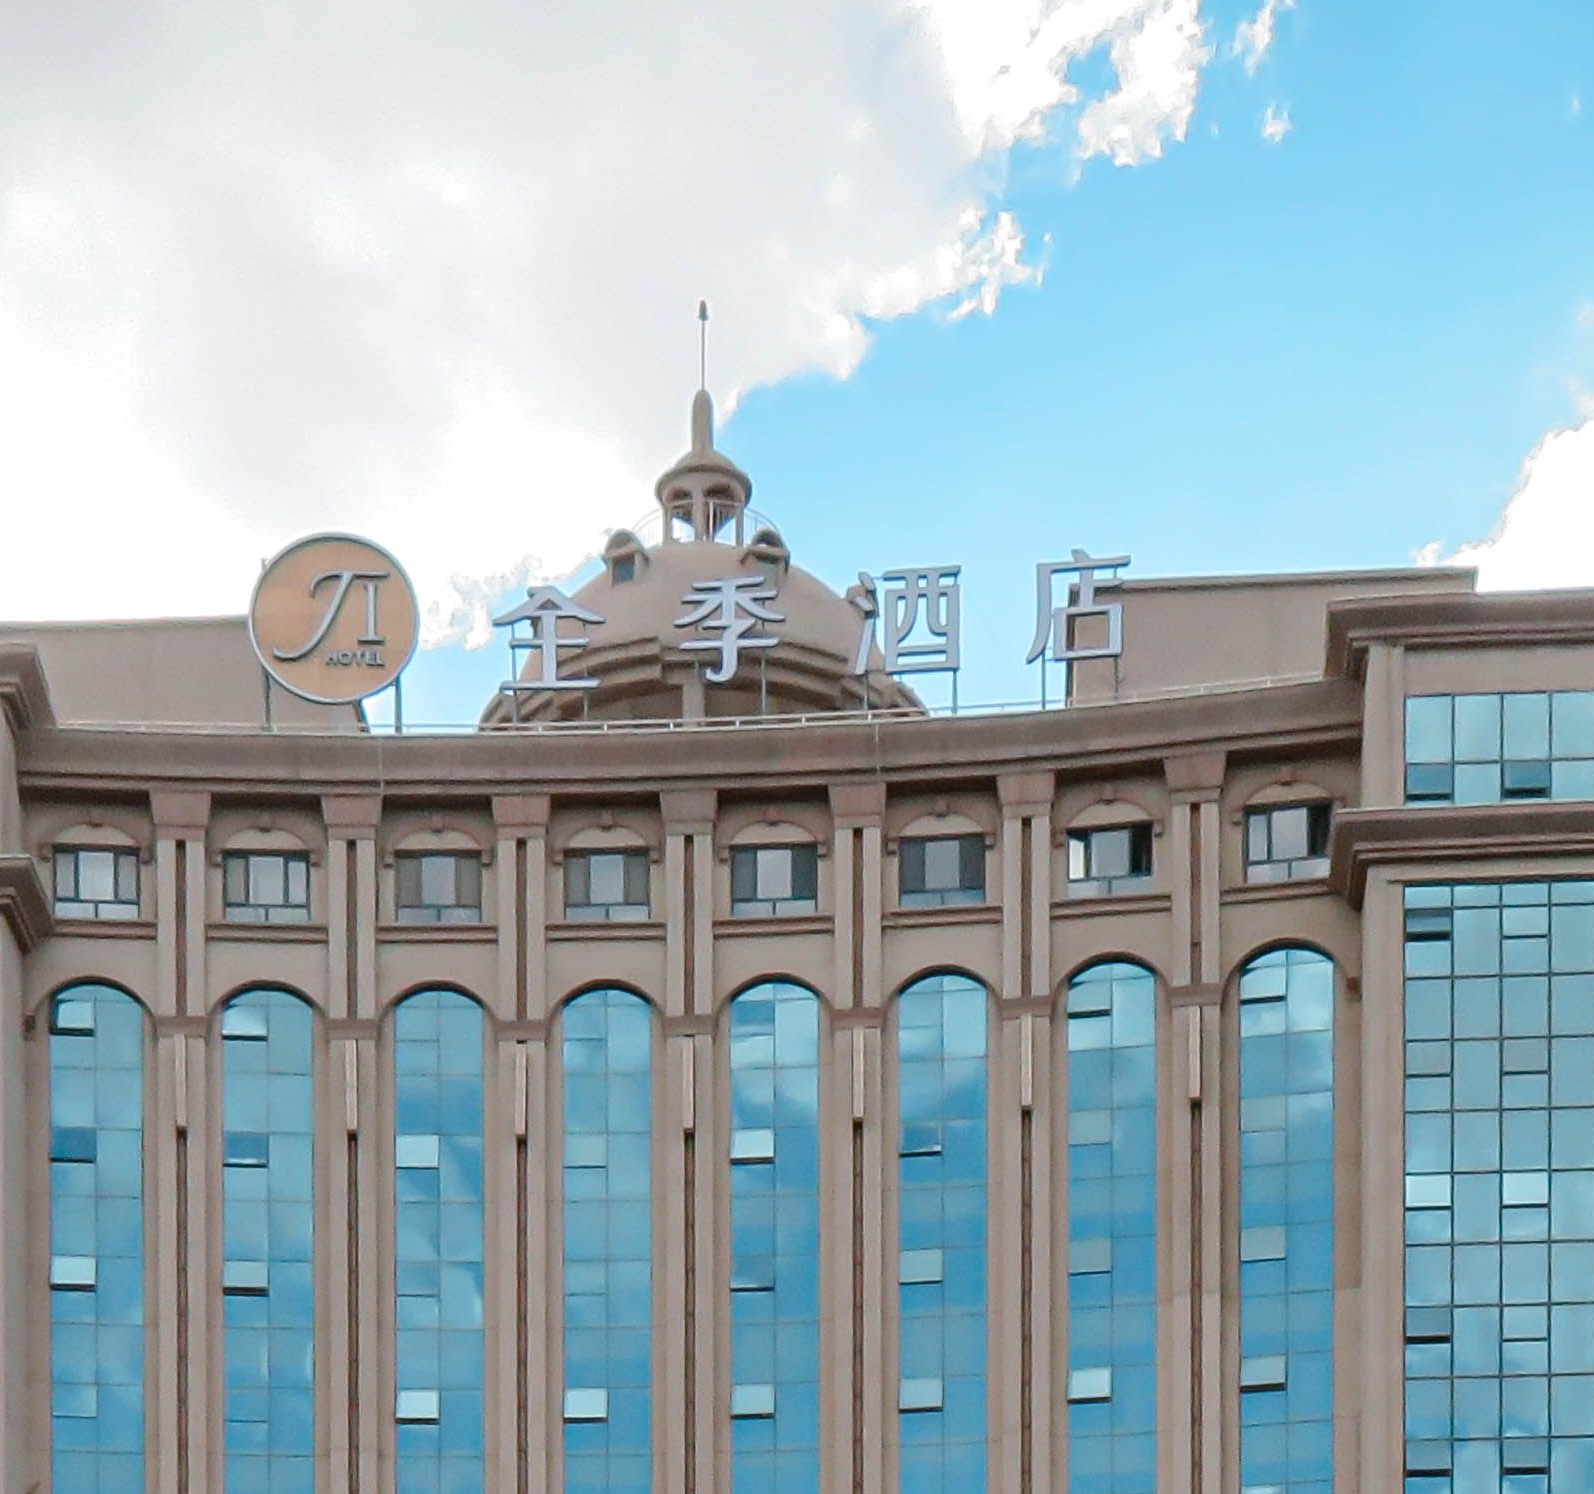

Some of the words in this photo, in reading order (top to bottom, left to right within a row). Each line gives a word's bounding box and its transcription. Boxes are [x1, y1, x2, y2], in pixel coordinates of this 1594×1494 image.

[326, 650, 385, 667] HOTEL
[492, 548, 1132, 690] 全季酒店
